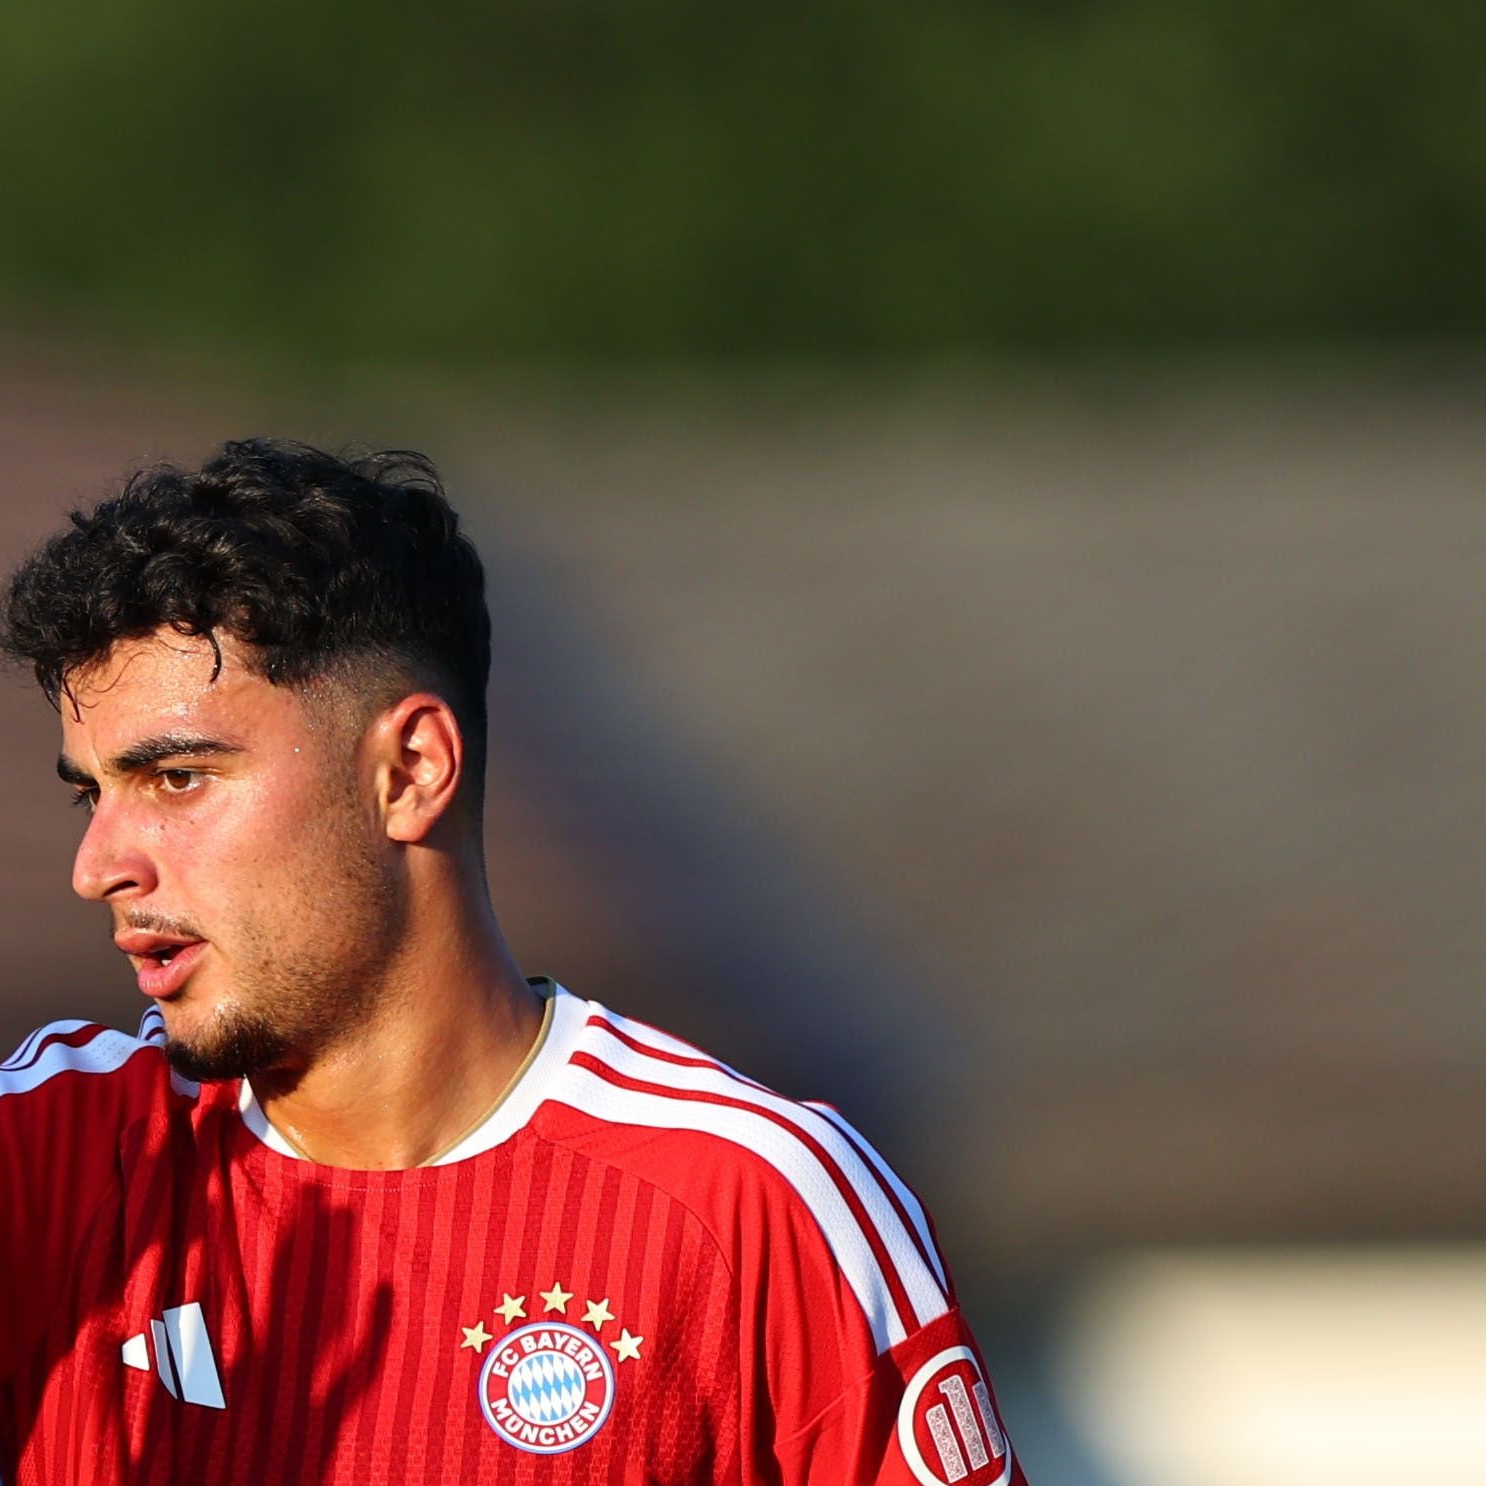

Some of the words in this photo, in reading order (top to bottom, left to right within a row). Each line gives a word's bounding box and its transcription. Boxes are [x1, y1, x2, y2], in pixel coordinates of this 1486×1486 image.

[492, 1348, 520, 1378] FC
[520, 1332, 603, 1381] BAYERN
[491, 1398, 600, 1445] MÜNCHEN
